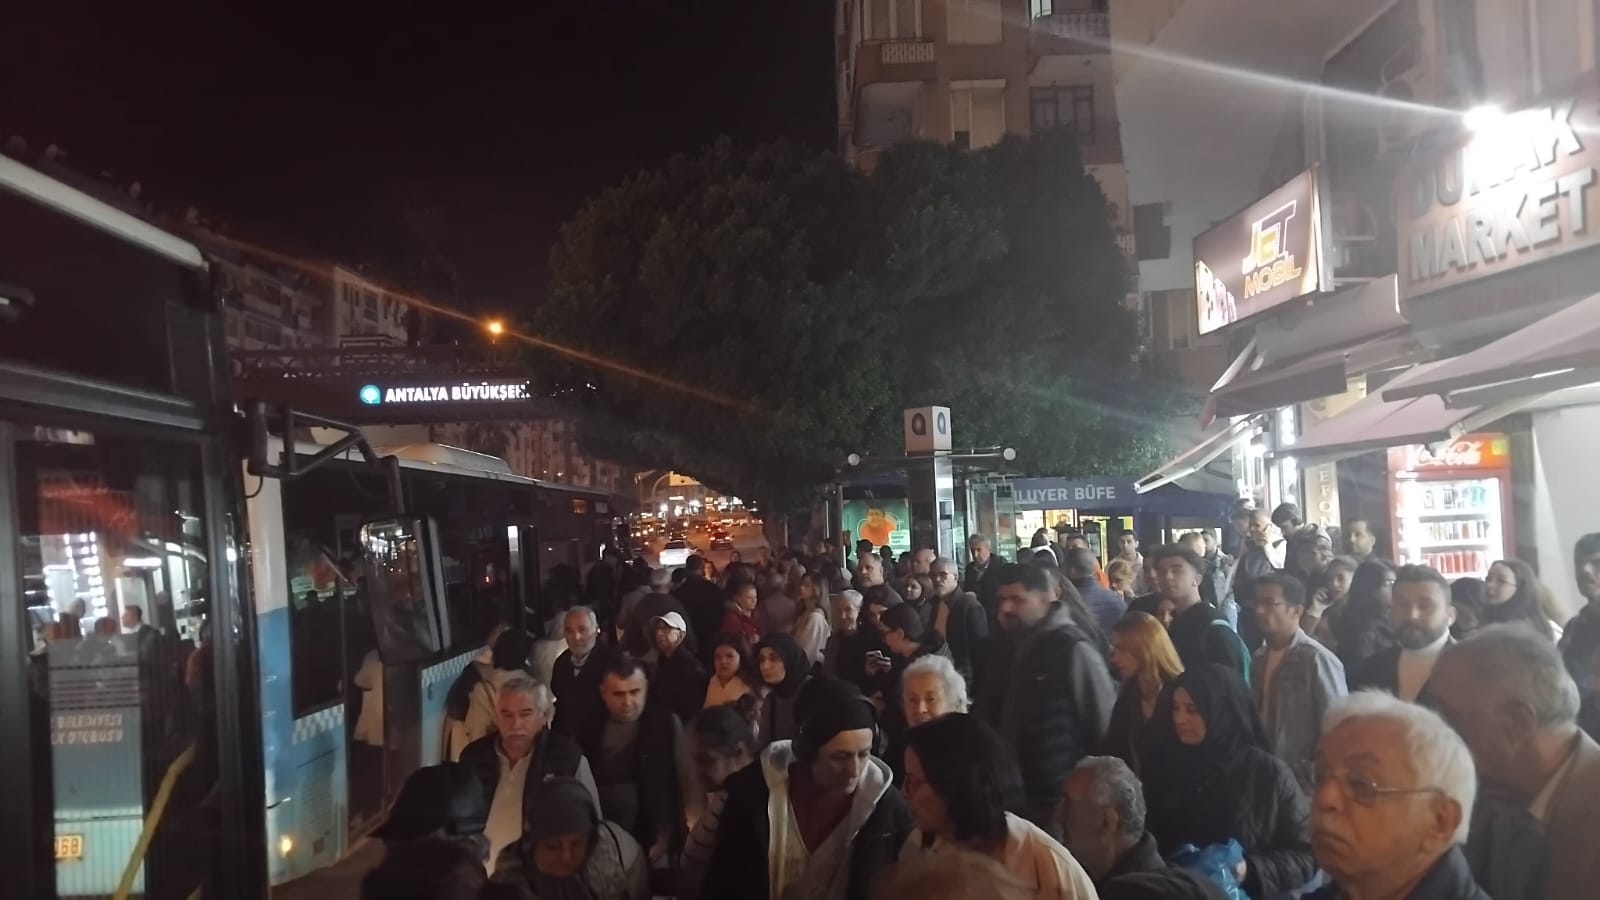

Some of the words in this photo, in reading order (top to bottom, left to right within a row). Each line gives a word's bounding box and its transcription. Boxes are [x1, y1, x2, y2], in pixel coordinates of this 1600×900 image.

[1411, 100, 1585, 220] DUAK
[1242, 199, 1297, 275] JET
[1409, 167, 1595, 283] MARKET
[385, 386, 449, 402] ANTALYA
[1074, 484, 1117, 501] BÜFE
